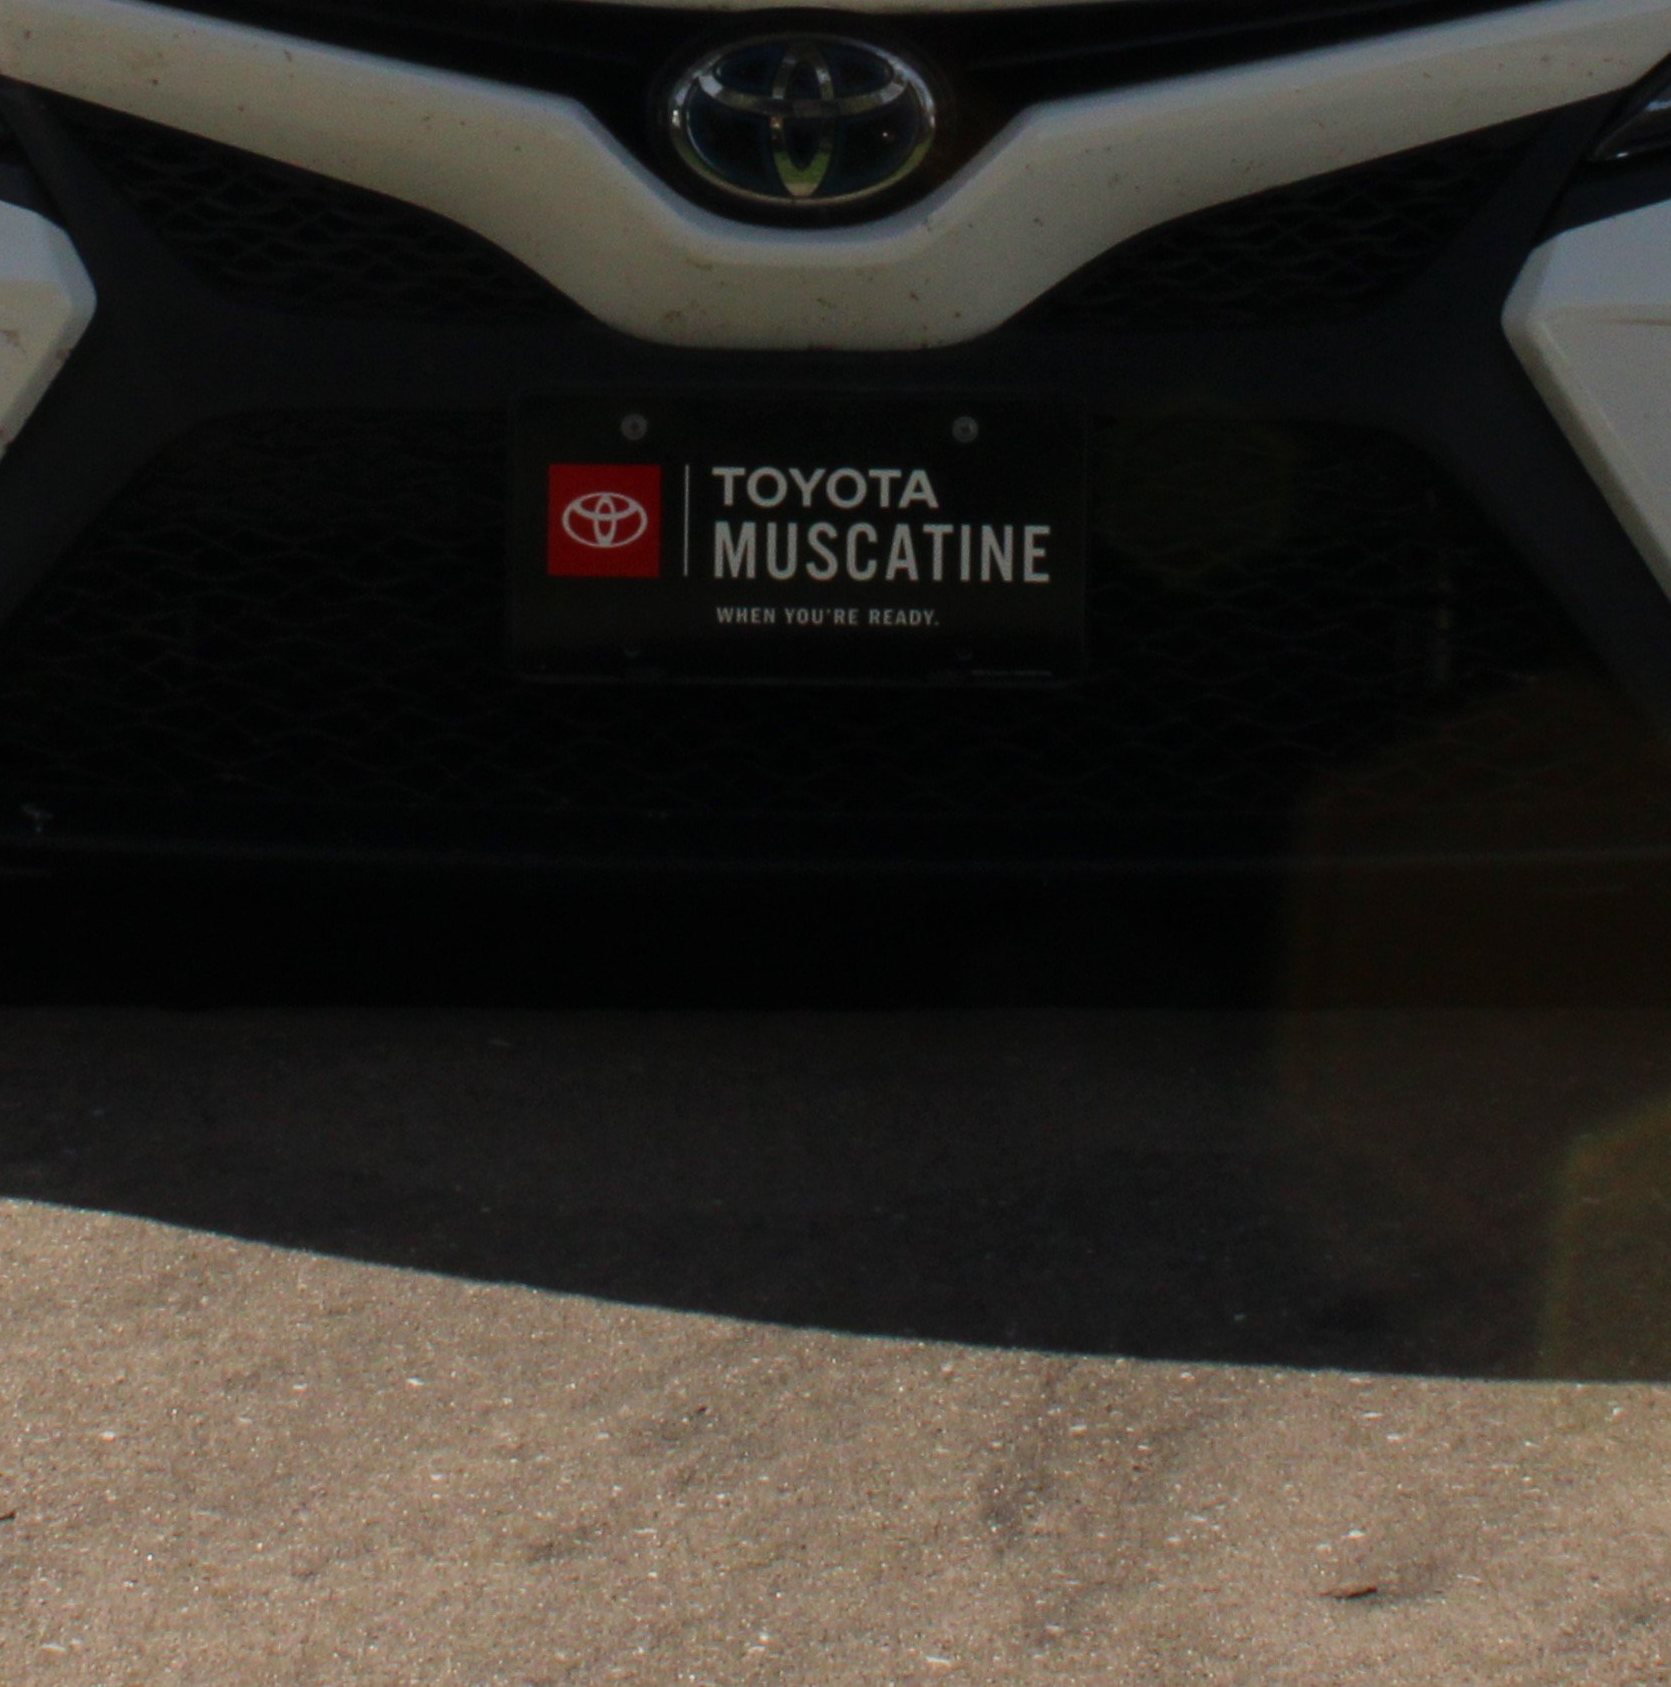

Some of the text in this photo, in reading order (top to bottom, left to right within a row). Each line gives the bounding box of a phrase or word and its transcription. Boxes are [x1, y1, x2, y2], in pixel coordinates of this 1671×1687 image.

[712, 466, 939, 508] TOYOTA
[714, 520, 1050, 583] MUSCATINE
[716, 606, 939, 626] WHEN YOU'RE READY.
